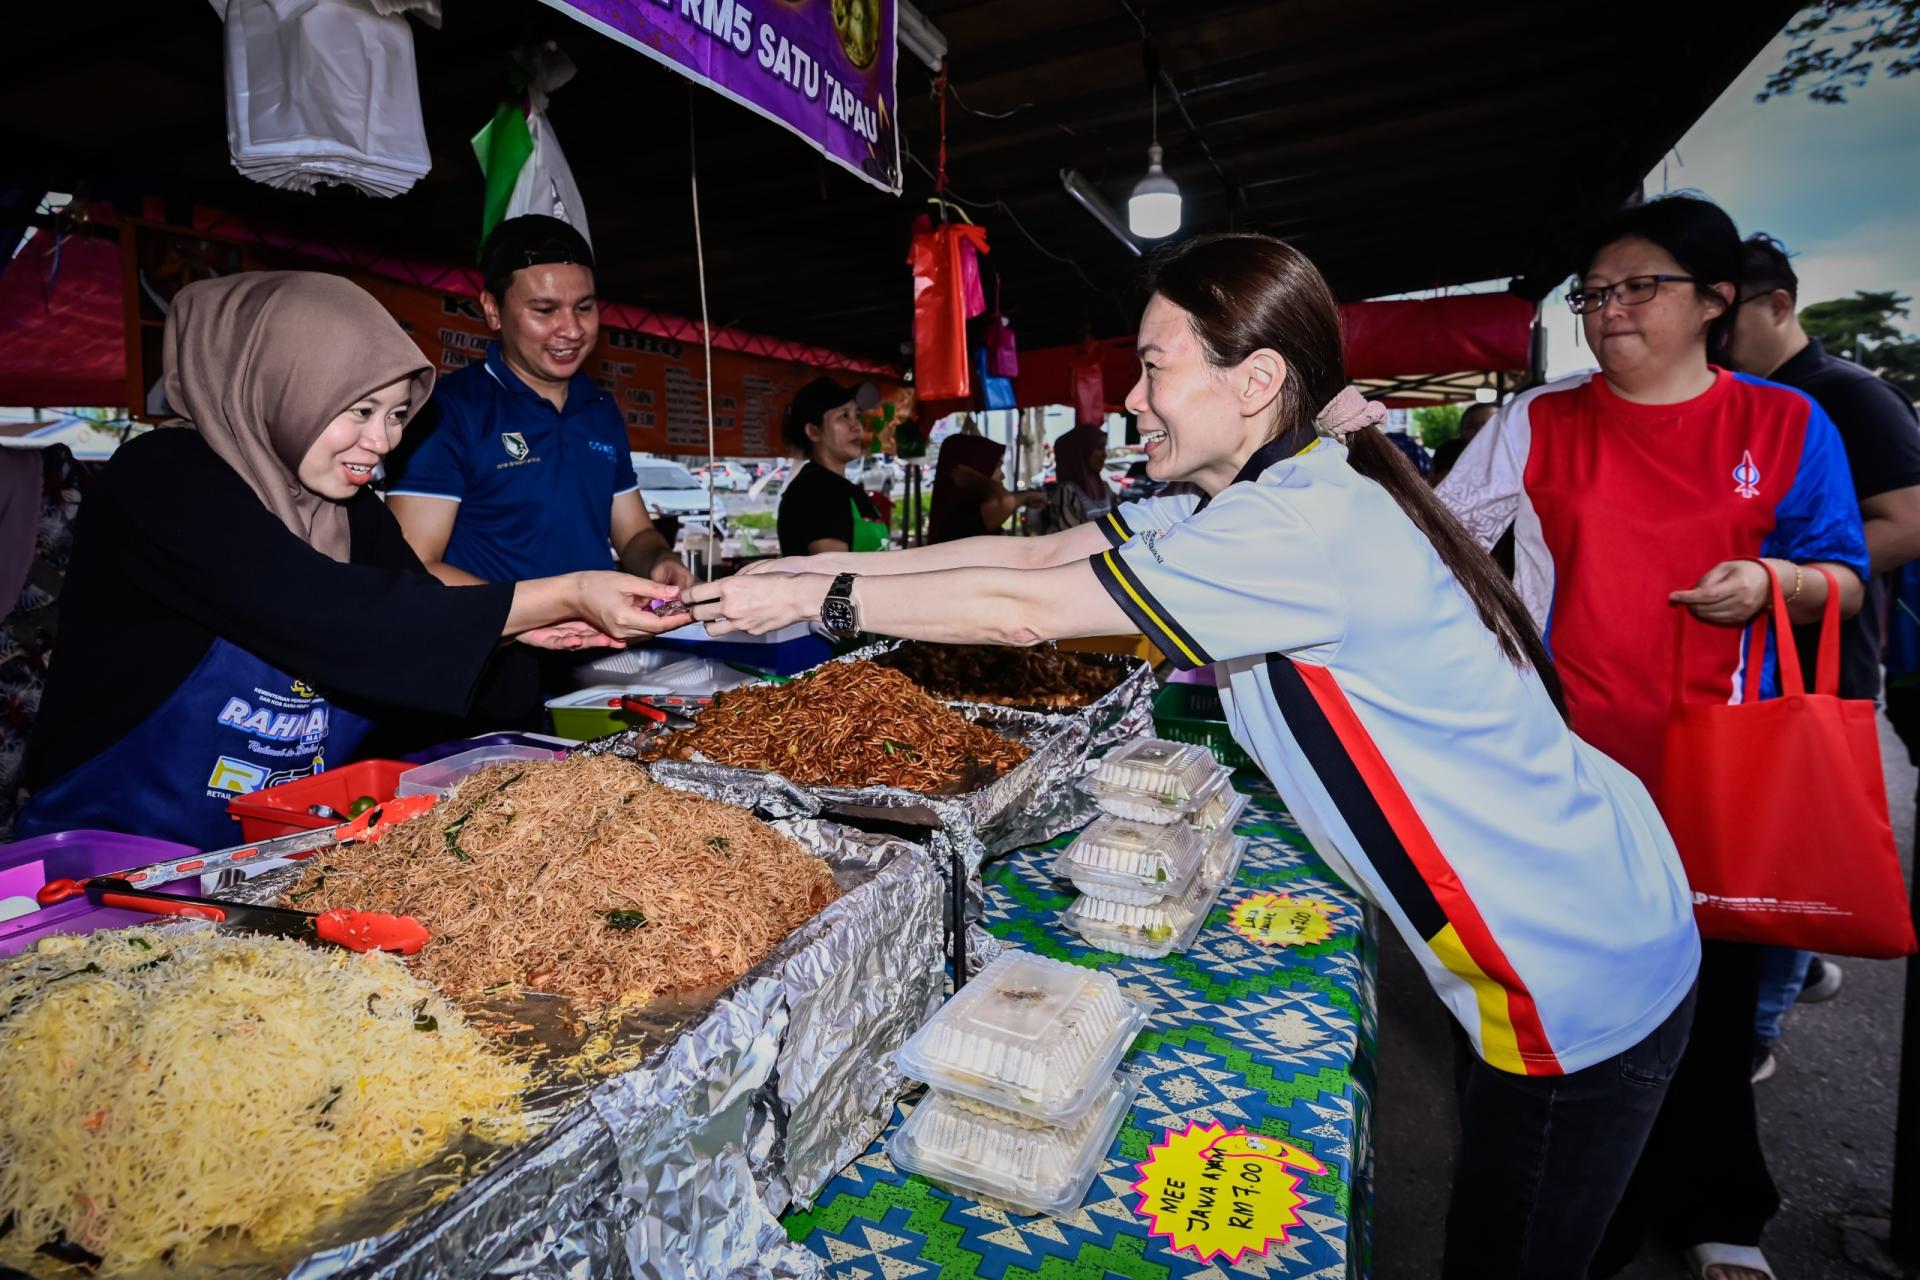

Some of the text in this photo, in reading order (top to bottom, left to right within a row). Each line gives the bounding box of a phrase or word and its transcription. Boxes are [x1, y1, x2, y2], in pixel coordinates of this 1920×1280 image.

[757, 23, 820, 98] SATU
[823, 69, 878, 144] TAPAU
[1160, 1177, 1186, 1214] MEE
[1186, 1186, 1219, 1232] JAWA
